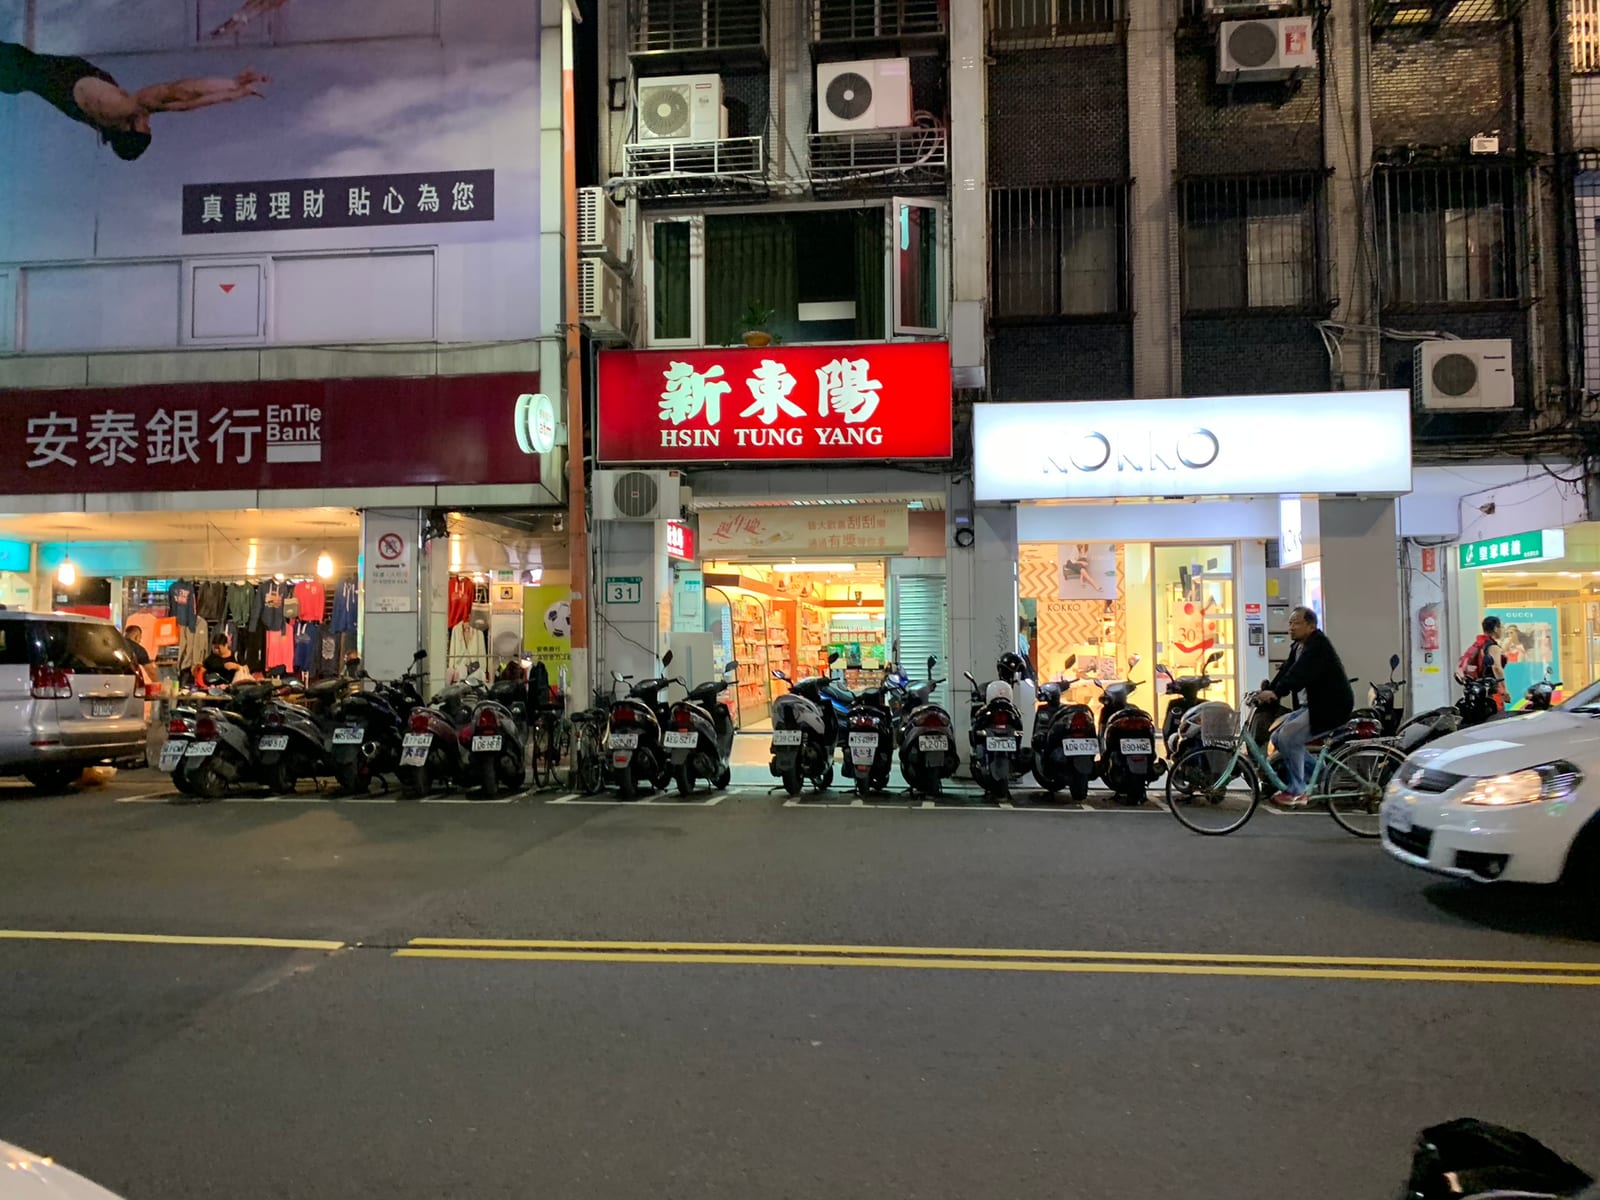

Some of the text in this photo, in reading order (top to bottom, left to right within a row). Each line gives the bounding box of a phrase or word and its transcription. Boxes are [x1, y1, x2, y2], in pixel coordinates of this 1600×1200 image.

[201, 182, 476, 223] 真誠理財 貼心為您
[657, 358, 883, 426] 新東陽
[266, 404, 322, 423] EnTie
[25, 407, 262, 468] 安泰銀行
[266, 423, 321, 441] Bank
[660, 427, 884, 448] HSIN TUNG YANG
[614, 587, 632, 600] 31
[1047, 603, 1081, 612] KOKKO
